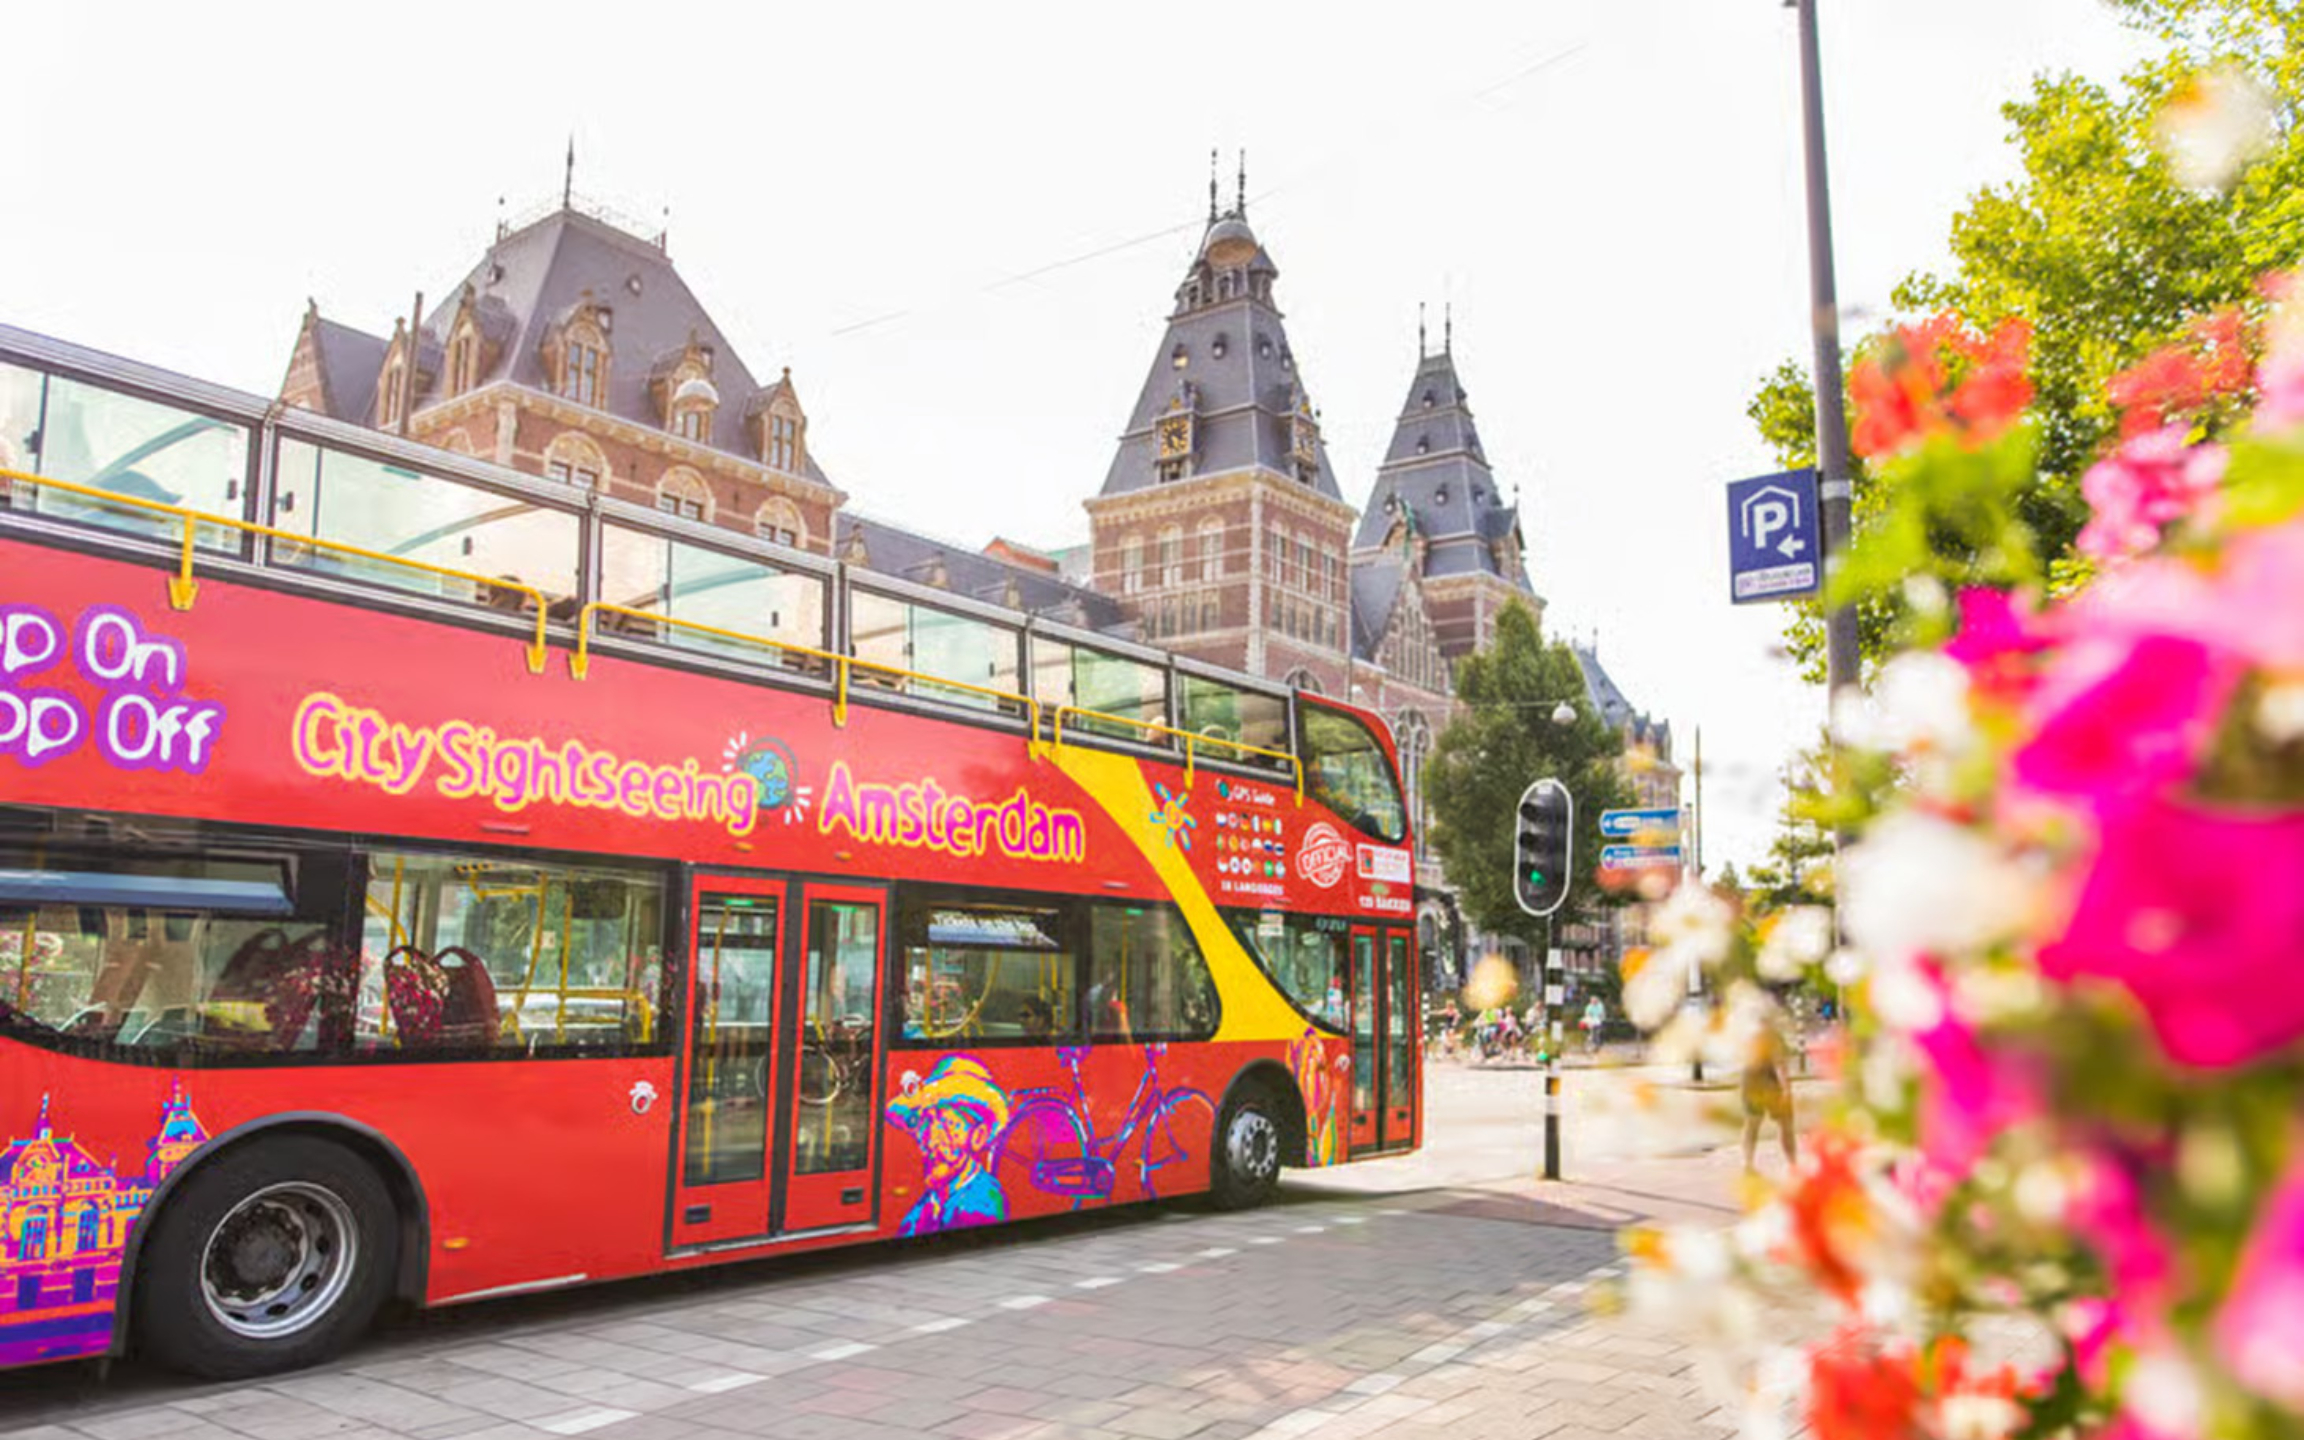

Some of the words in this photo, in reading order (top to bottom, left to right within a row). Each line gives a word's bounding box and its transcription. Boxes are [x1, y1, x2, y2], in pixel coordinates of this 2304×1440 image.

[1753, 501, 1788, 549] P
[84, 612, 178, 685] On
[106, 693, 219, 765] Off
[292, 691, 434, 796] City
[436, 719, 759, 836] Sightseeing
[817, 760, 1086, 864] Amsterdam
